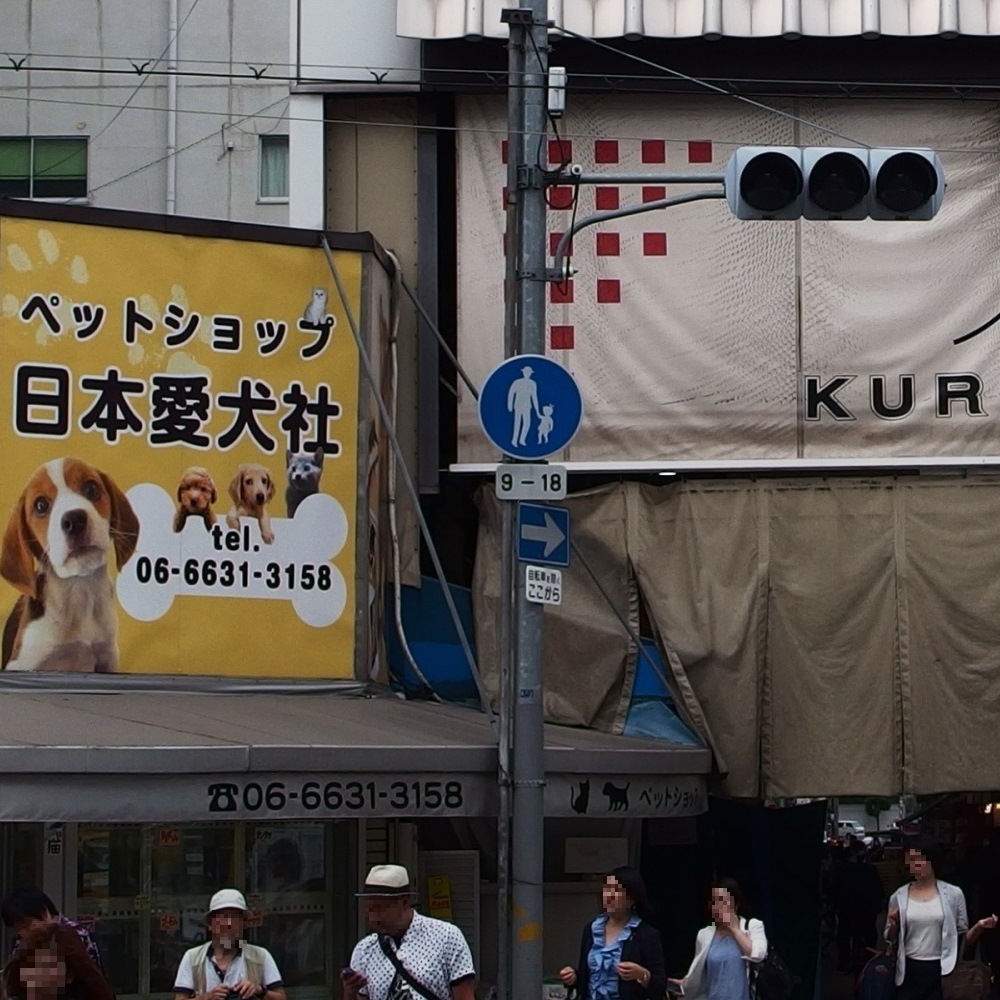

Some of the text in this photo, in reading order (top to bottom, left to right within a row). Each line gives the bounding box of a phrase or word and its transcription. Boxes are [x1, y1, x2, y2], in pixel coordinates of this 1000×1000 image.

[20, 293, 334, 359] ペットショップ
[15, 363, 341, 457] 日本愛犬社
[212, 525, 260, 552] tel.
[136, 556, 332, 591] 06-6631-3158
[529, 583, 560, 602] ここから
[242, 781, 463, 811] 06-6631-3158
